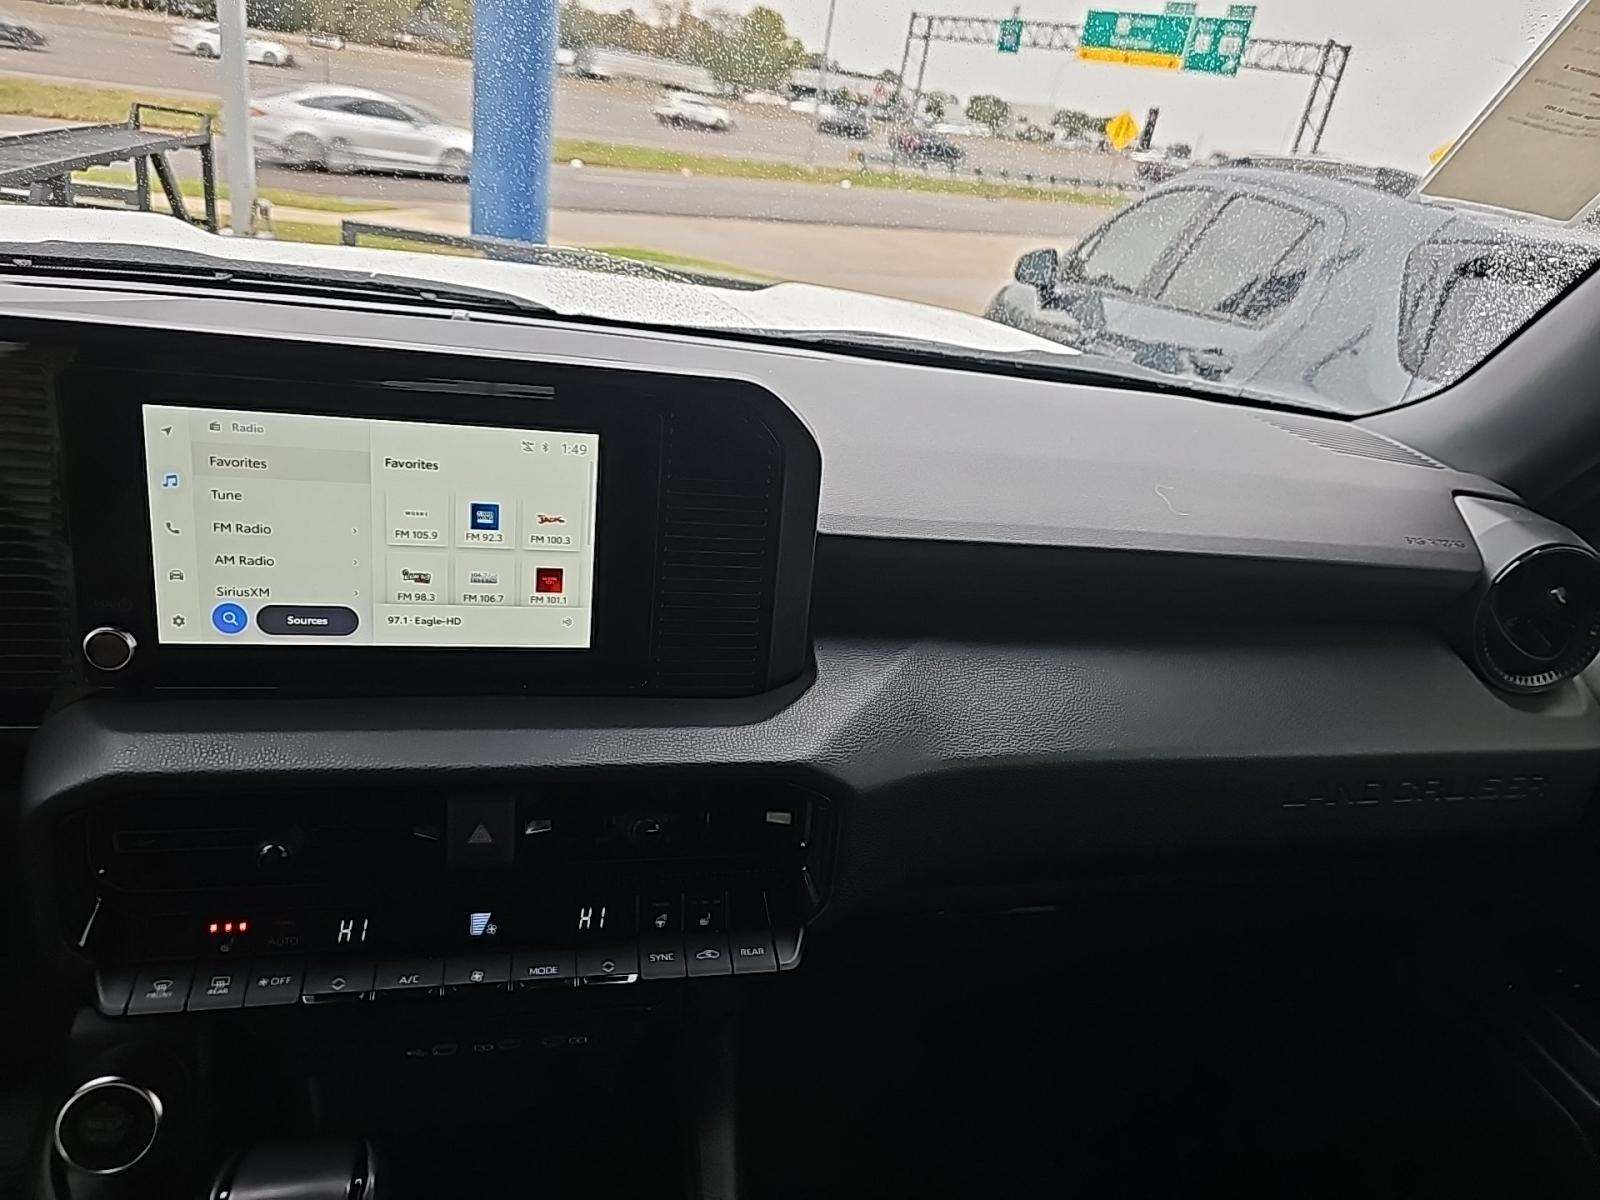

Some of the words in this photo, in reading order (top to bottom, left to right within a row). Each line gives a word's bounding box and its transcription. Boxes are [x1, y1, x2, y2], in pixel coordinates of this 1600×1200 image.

[231, 422, 265, 434] Radio
[561, 442, 588, 456] 1:49
[209, 455, 268, 470] Favorites
[384, 457, 440, 471] Favorites
[210, 489, 243, 501] Tune
[213, 522, 232, 534] FM
[235, 522, 272, 535] Radio
[394, 529, 410, 540] FM
[413, 530, 438, 540] 105.9
[465, 532, 480, 542] FM
[482, 533, 504, 543] 92.3
[530, 535, 545, 545] FM
[546, 536, 571, 545] 100.3
[214, 555, 236, 566] AM
[238, 554, 275, 567] Radio
[215, 586, 271, 598] SiriusXM
[397, 592, 412, 601] FM
[414, 592, 436, 602] 98.3
[463, 594, 478, 603] FM
[479, 594, 504, 603] 106.7
[530, 596, 544, 604] FM
[546, 596, 567, 605] 101.1
[286, 615, 329, 626] Sources
[387, 615, 408, 625] 97.1
[414, 616, 462, 627] Eagle-HD
[648, 952, 676, 963] SYNC
[739, 947, 766, 957] REAR
[528, 965, 559, 977] MODE
[269, 975, 293, 986] OFF
[398, 973, 421, 985] A/C
[207, 987, 230, 996] REAR
